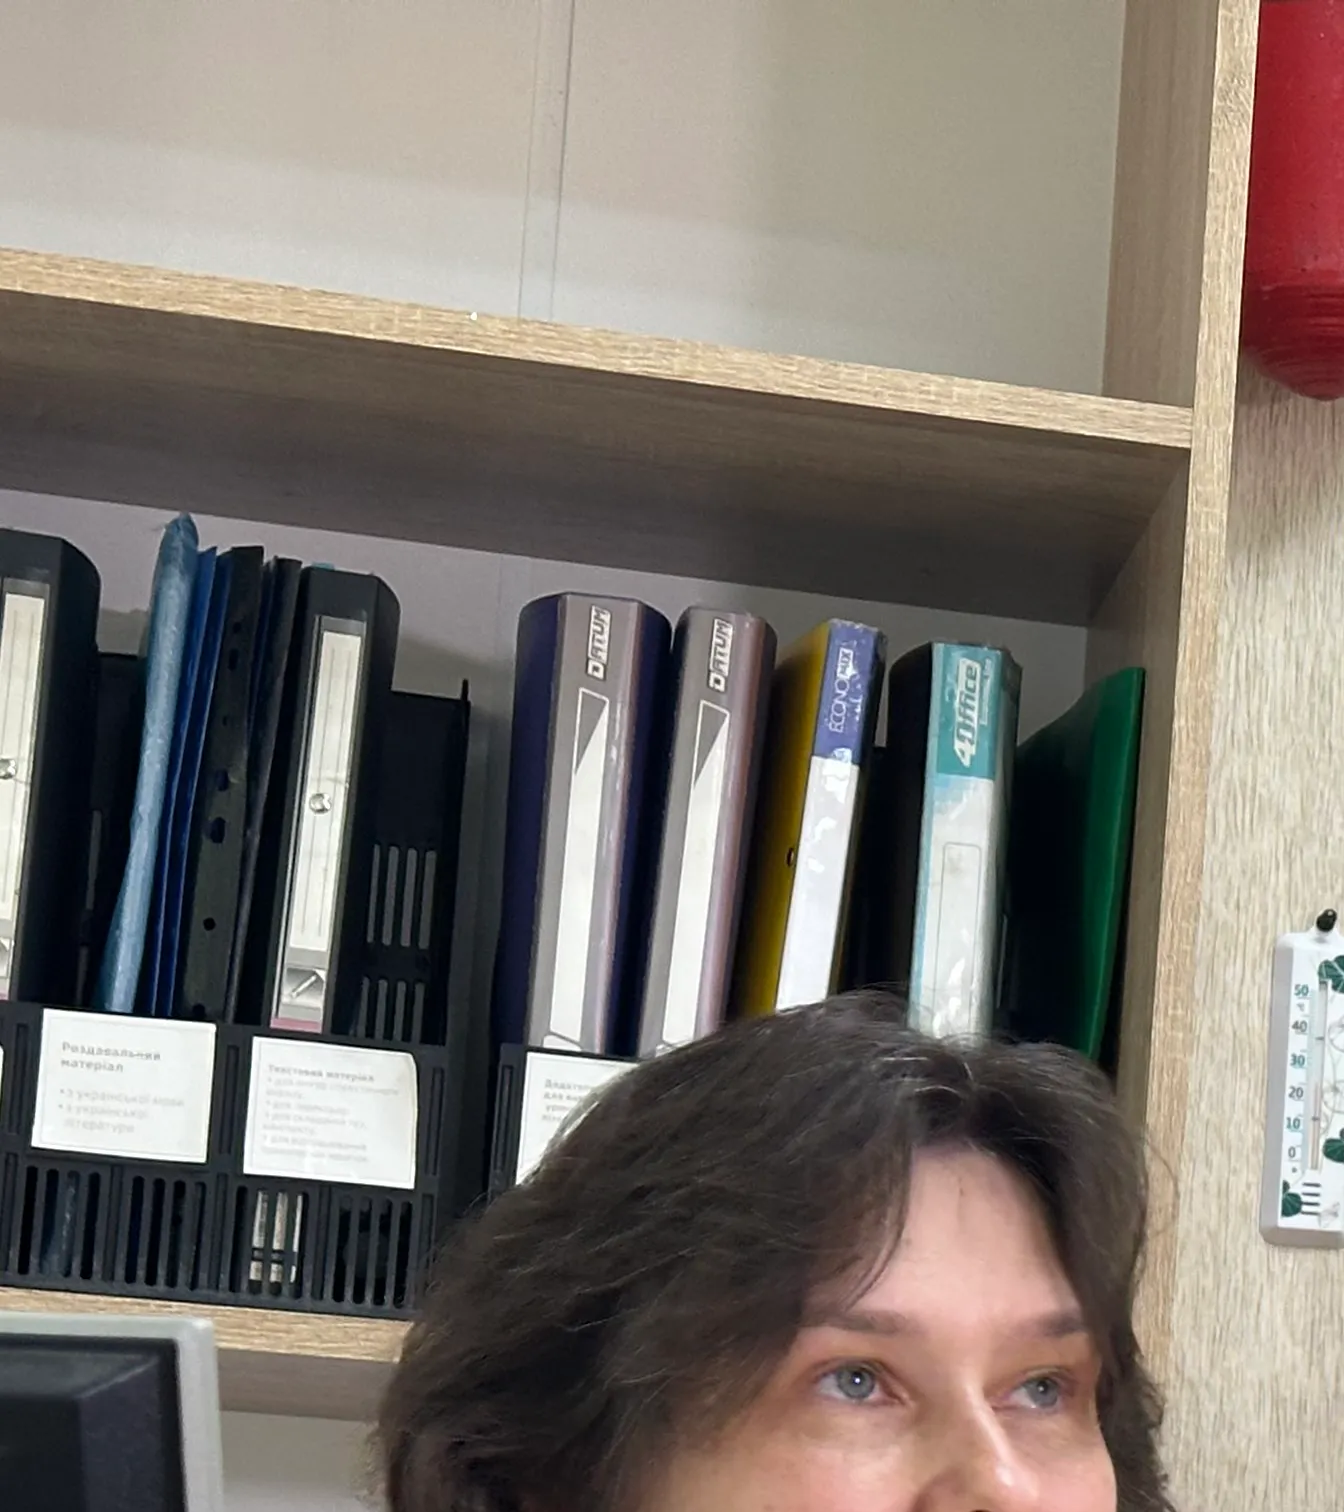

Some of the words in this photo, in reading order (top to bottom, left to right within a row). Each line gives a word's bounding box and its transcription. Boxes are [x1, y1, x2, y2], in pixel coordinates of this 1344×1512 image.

[587, 605, 612, 680] DATUM
[707, 618, 733, 692] DATUM
[1294, 984, 1309, 997] 50
[1292, 1020, 1308, 1033] 40
[60, 1058, 124, 1073] матеріал
[1290, 1054, 1306, 1067] 30
[1288, 1086, 1304, 1099] 20
[1286, 1117, 1301, 1130] 10
[1288, 1146, 1297, 1159] 0
